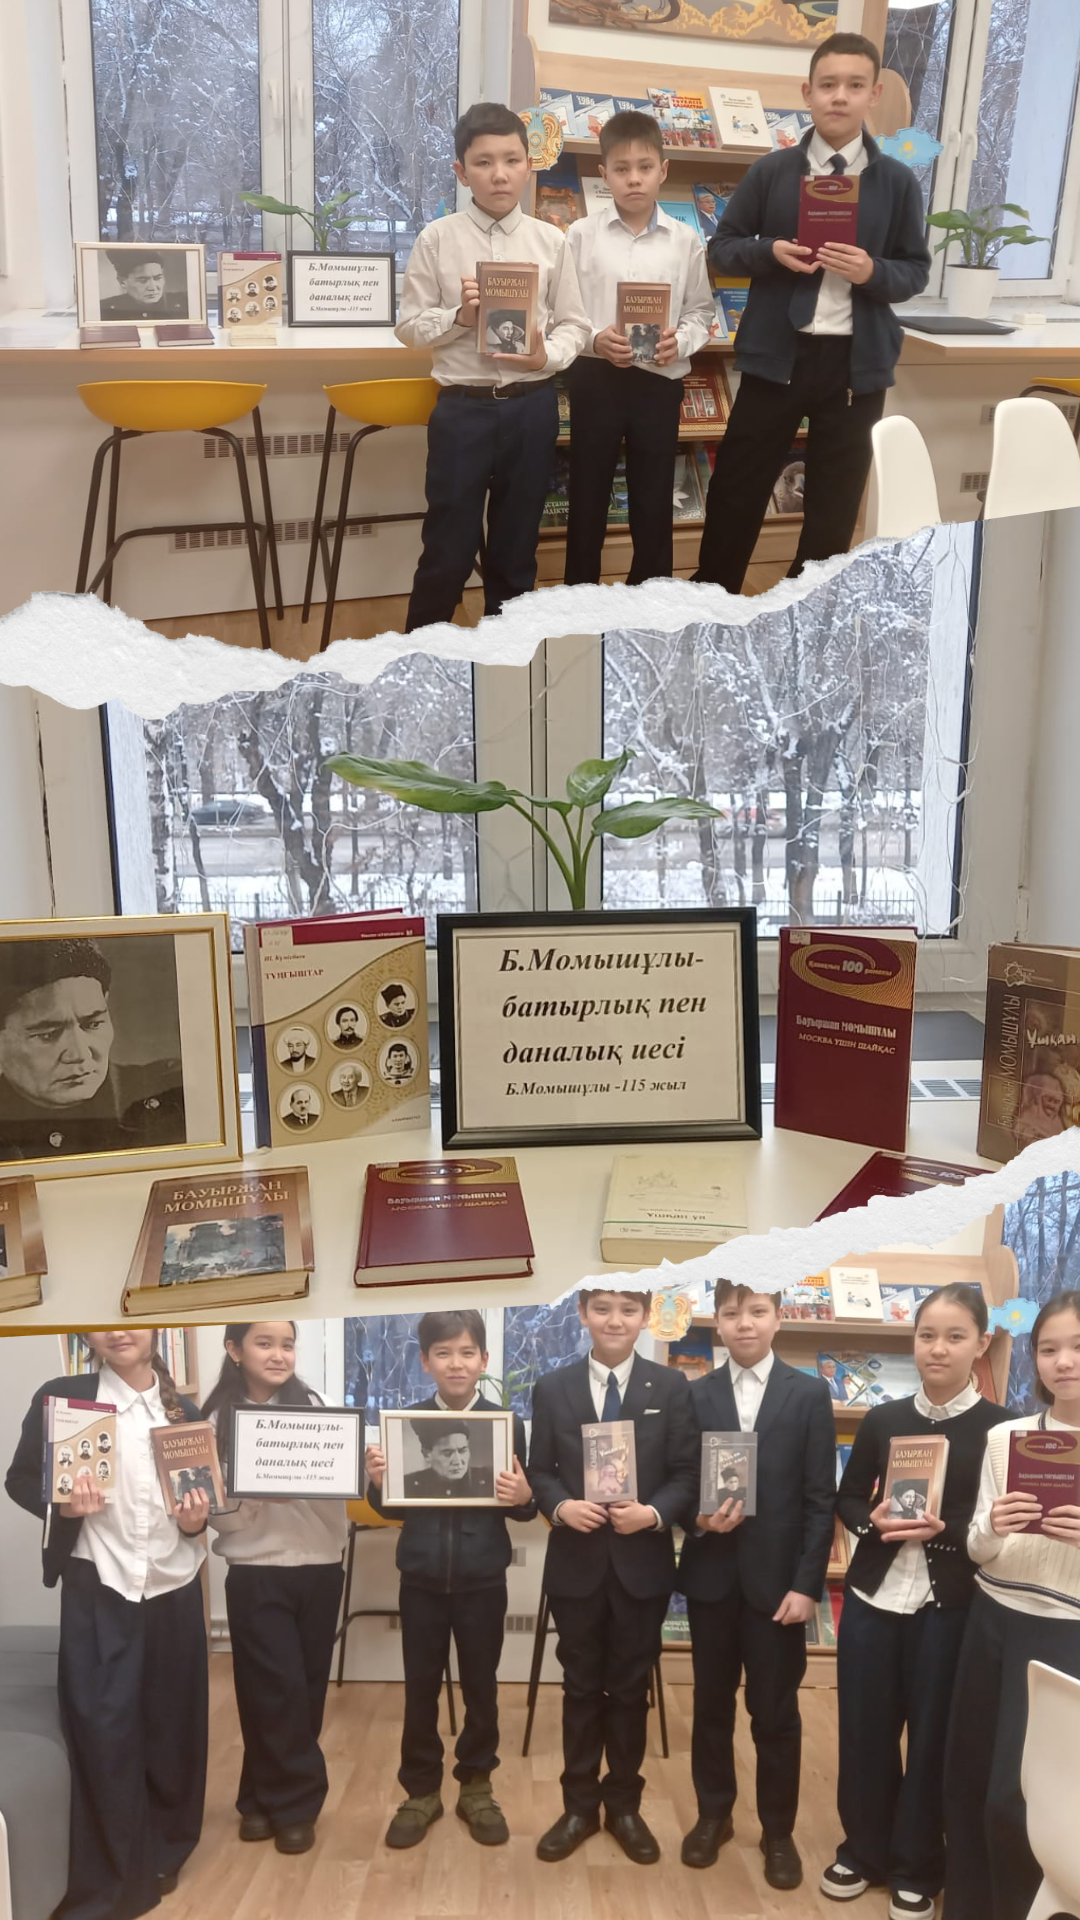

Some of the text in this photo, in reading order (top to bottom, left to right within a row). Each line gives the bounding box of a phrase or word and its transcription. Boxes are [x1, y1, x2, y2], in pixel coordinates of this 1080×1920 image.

[308, 277, 361, 288] батырлық
[487, 277, 528, 287] БАУЫРЖАН
[309, 292, 372, 302] даналық иесі
[498, 948, 704, 975] Б.Момышұлы-
[842, 960, 863, 974] 100
[502, 995, 707, 1022] батырлық пен
[798, 1033, 833, 1045] МОСКВА
[857, 1041, 896, 1055] ШАЙҚАС
[1000, 994, 1021, 1080] МОМЫШҰЛЫ
[503, 1036, 686, 1066] даналық иесі
[649, 1080, 687, 1092] жыл
[173, 1181, 282, 1200] БАУЫРЖАН
[162, 1435, 205, 1449] БАУЫРЖАН
[255, 1437, 344, 1451] батырлық пен
[895, 1449, 933, 1459] БАУЫРЖАН
[255, 1456, 335, 1469] даналық иесі
